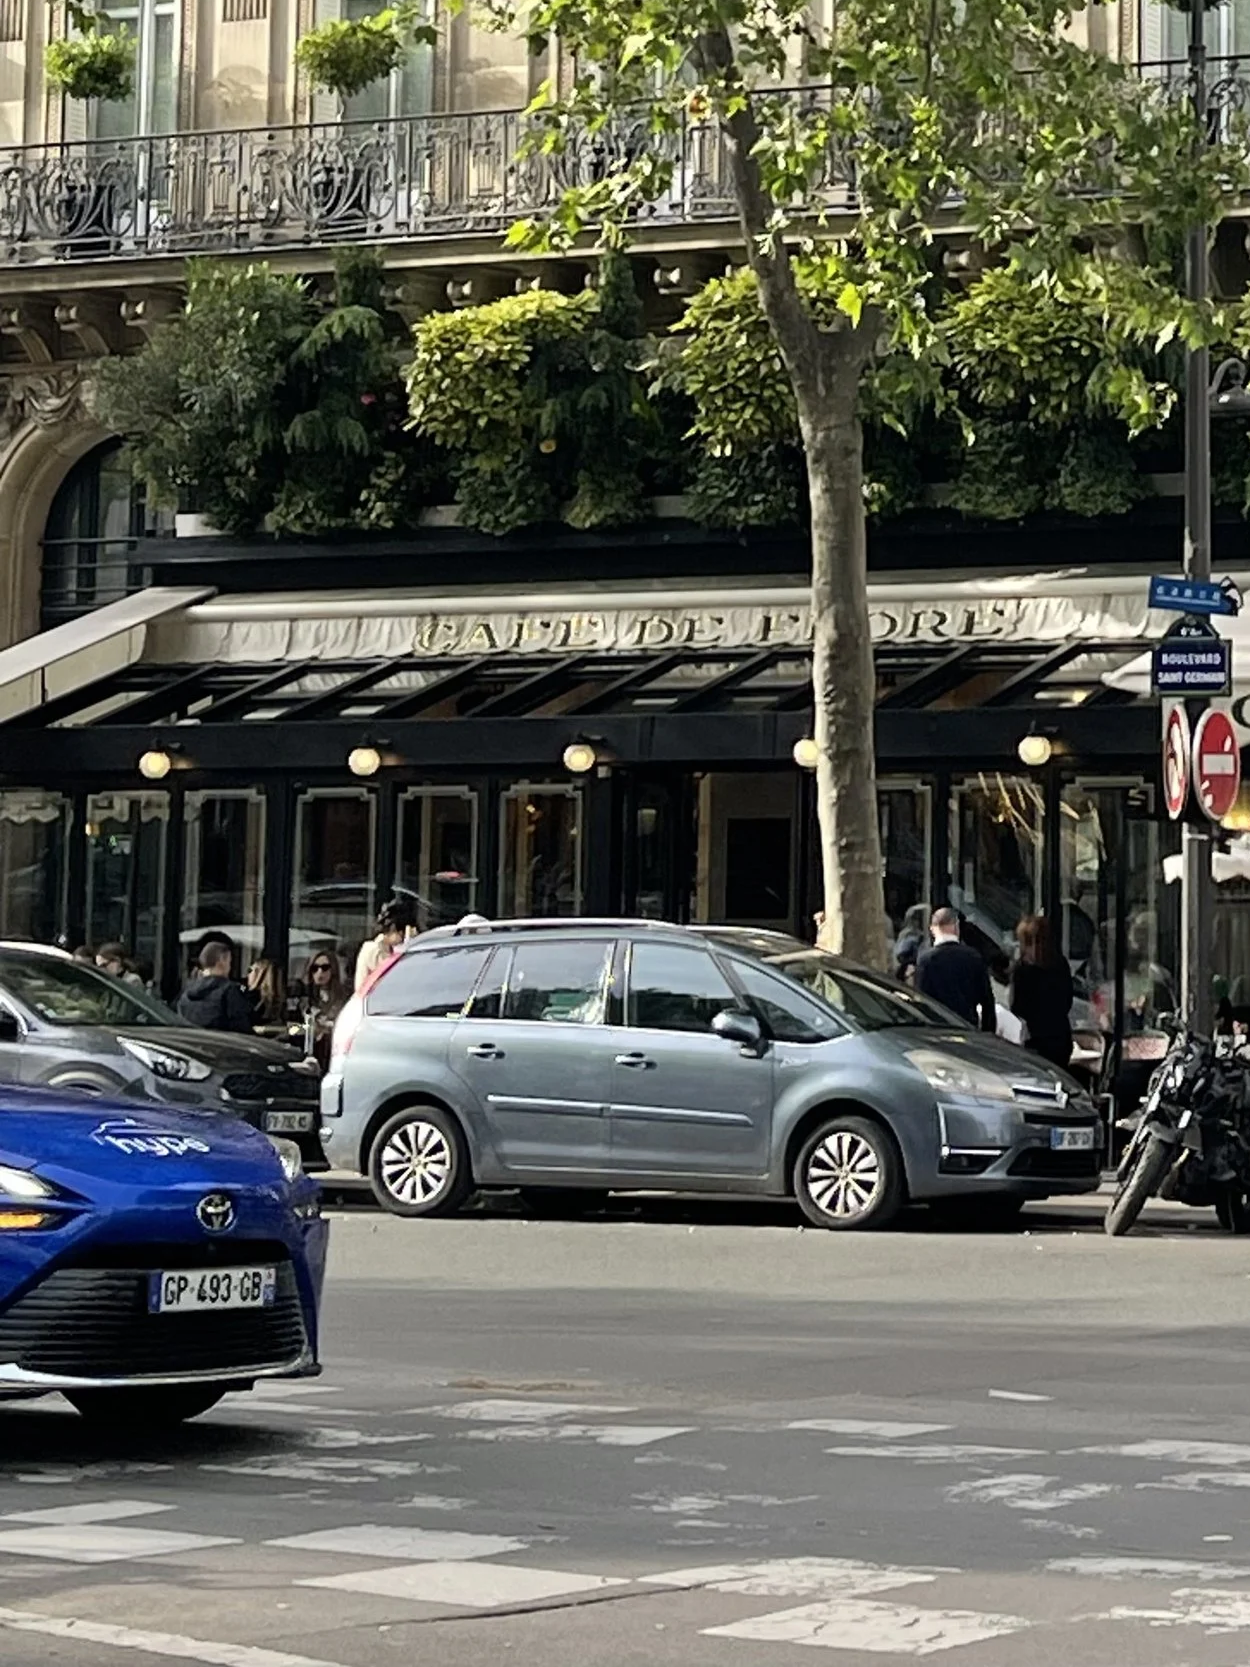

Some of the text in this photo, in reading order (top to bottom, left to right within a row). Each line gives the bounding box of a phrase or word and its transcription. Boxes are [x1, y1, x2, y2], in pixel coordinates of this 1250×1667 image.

[631, 615, 725, 646] DE
[758, 608, 1005, 642] FORE
[1161, 653, 1222, 665] BOULEVARD
[104, 1134, 210, 1156] hype
[164, 1270, 263, 1306] GP-493-GB
